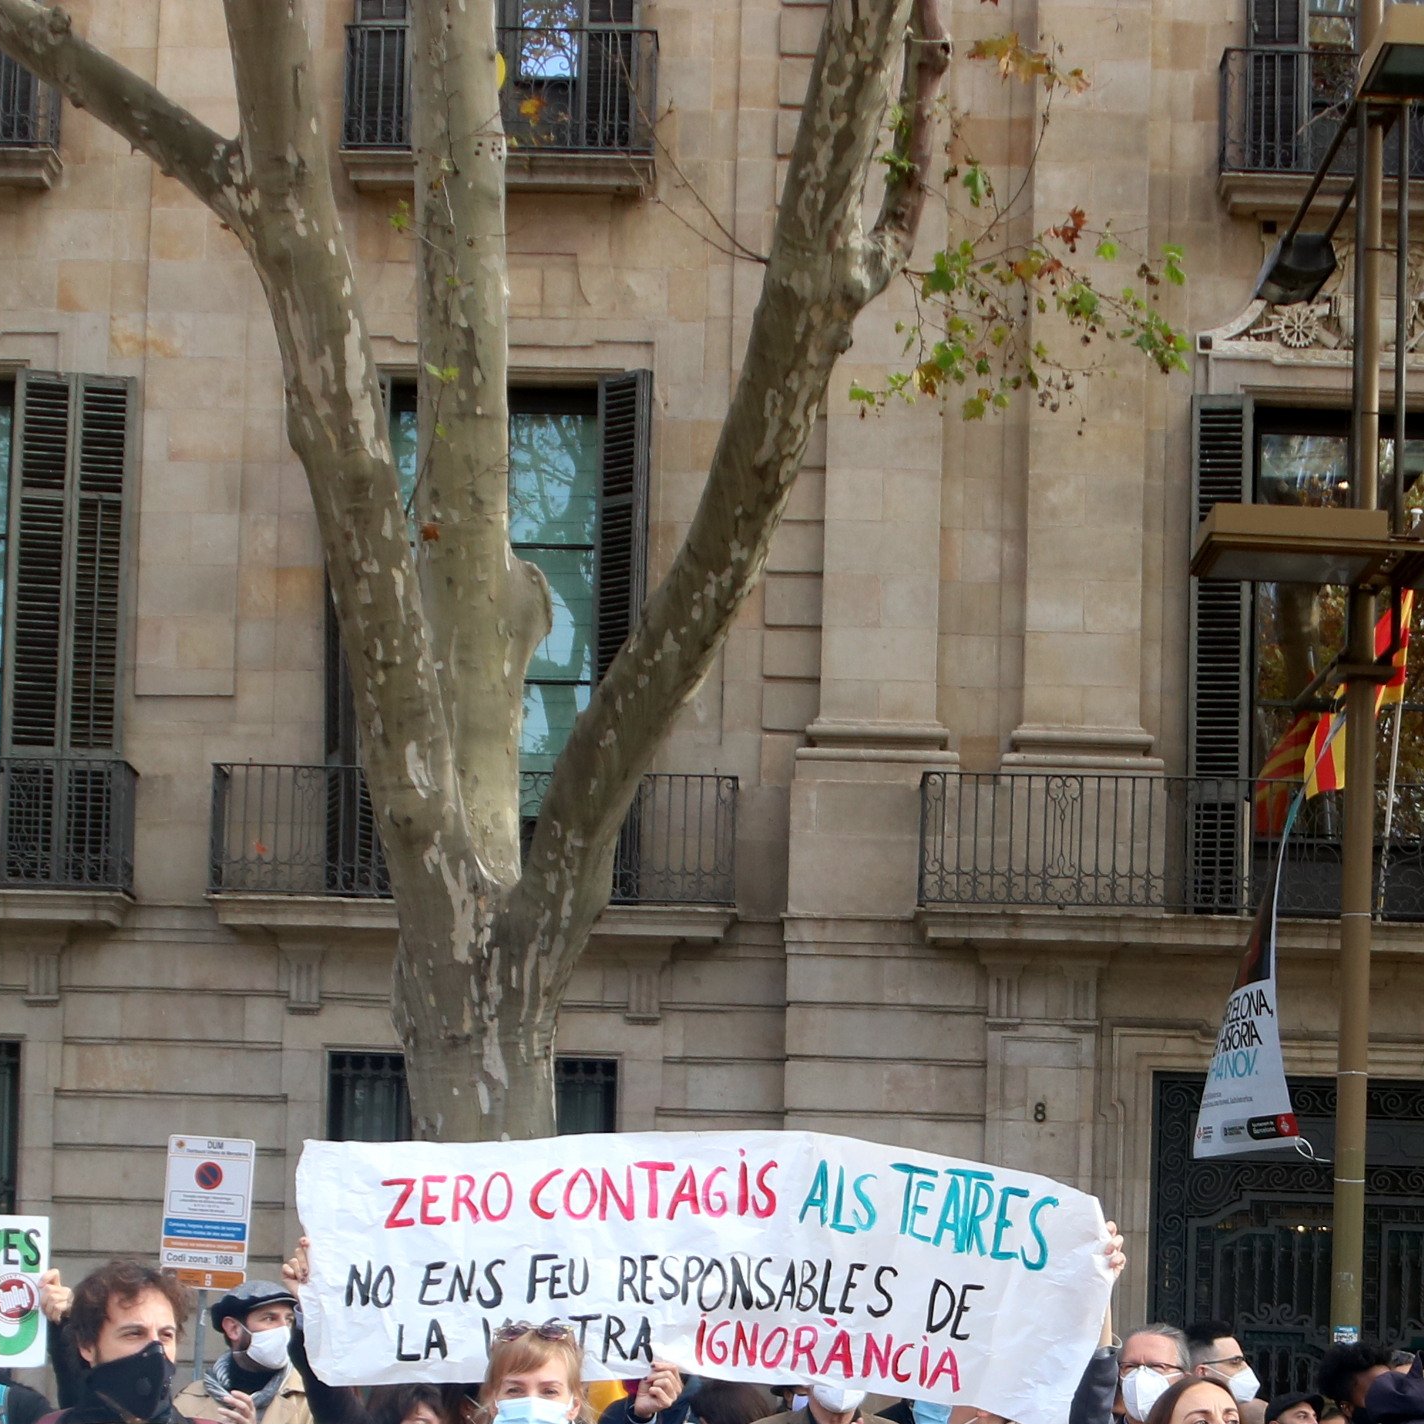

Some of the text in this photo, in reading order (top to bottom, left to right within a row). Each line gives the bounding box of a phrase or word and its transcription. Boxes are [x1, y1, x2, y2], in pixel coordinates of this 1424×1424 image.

[383, 1171, 513, 1229] ZERO
[799, 1159, 876, 1235] ALS
[892, 1161, 1060, 1271] TEATRES
[166, 1252, 186, 1262] Codi
[346, 1253, 985, 1341] NO ENS FEU RESPONSABLES DE
[397, 1320, 447, 1361] LA
[482, 1313, 653, 1363] VTRA
